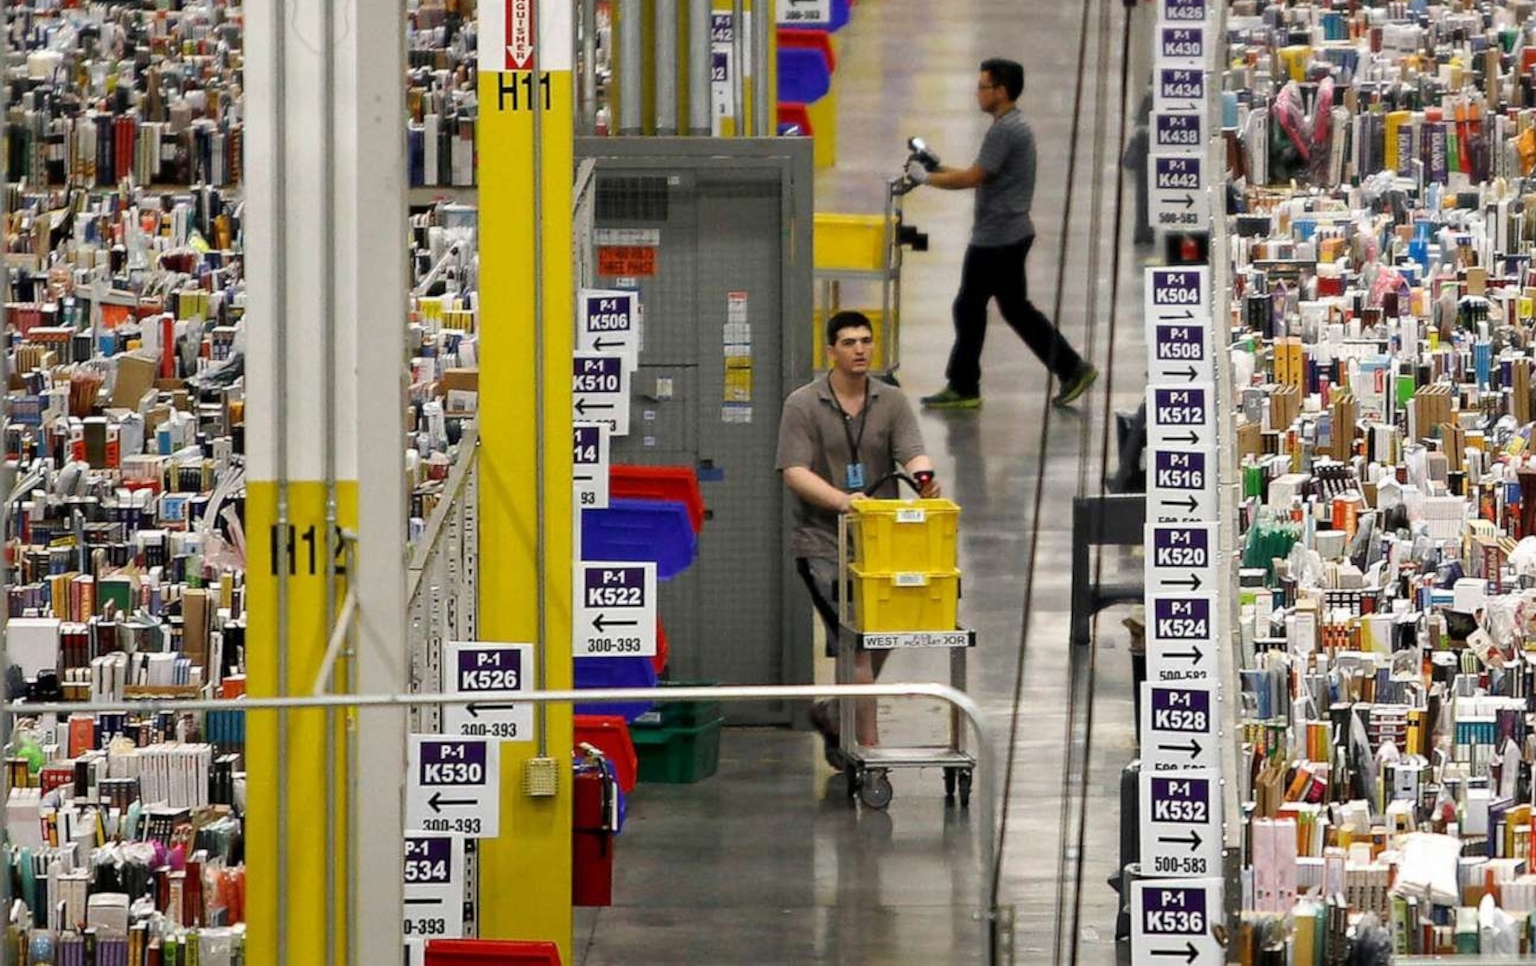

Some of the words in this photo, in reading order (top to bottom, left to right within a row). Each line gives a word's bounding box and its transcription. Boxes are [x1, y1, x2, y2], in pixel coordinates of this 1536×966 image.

[1164, 42, 1201, 56] K430
[1173, 71, 1190, 81] P-1
[498, 72, 551, 111] H11
[1163, 83, 1202, 97] K434
[1170, 117, 1186, 127] P-1
[1159, 129, 1198, 144] K438
[1169, 160, 1186, 170] P-1
[1158, 173, 1198, 188] K442
[1158, 213, 1198, 225] 500-583
[1166, 273, 1186, 285] P-1
[1156, 287, 1199, 304] K504
[600, 299, 617, 312] P-1
[590, 313, 628, 331] K506
[1170, 327, 1189, 340] P-1
[1159, 341, 1202, 359] K508
[584, 360, 604, 372] P-1
[574, 375, 618, 391] K510
[1169, 391, 1190, 404] P-1
[1158, 406, 1203, 424] K512
[574, 445, 596, 462] 14
[1169, 454, 1190, 468] P-1
[1158, 469, 1203, 488] K516
[1170, 531, 1191, 545] P-1
[271, 524, 347, 575] H12
[1157, 547, 1206, 566] K520
[603, 571, 626, 584] P-1
[588, 588, 641, 606] K522
[1171, 602, 1193, 616] P-1
[1158, 617, 1207, 638] K524
[588, 637, 641, 652] 300-393
[866, 636, 899, 647] WEST
[476, 653, 500, 667] P-1
[462, 670, 517, 689] K526
[1169, 692, 1191, 707] P-1
[1156, 709, 1206, 730] K528
[461, 723, 517, 737] 300-393
[440, 745, 465, 759] P-1
[425, 764, 482, 783] K530
[1168, 782, 1190, 797] P-1
[1155, 799, 1206, 821] K532
[422, 818, 481, 833] 300-393
[404, 840, 429, 856] P-1
[404, 859, 447, 881] 534
[1155, 857, 1207, 874] 500-583
[1161, 890, 1185, 907] P-1
[404, 918, 446, 935] 0-393
[1147, 910, 1204, 933] K536
